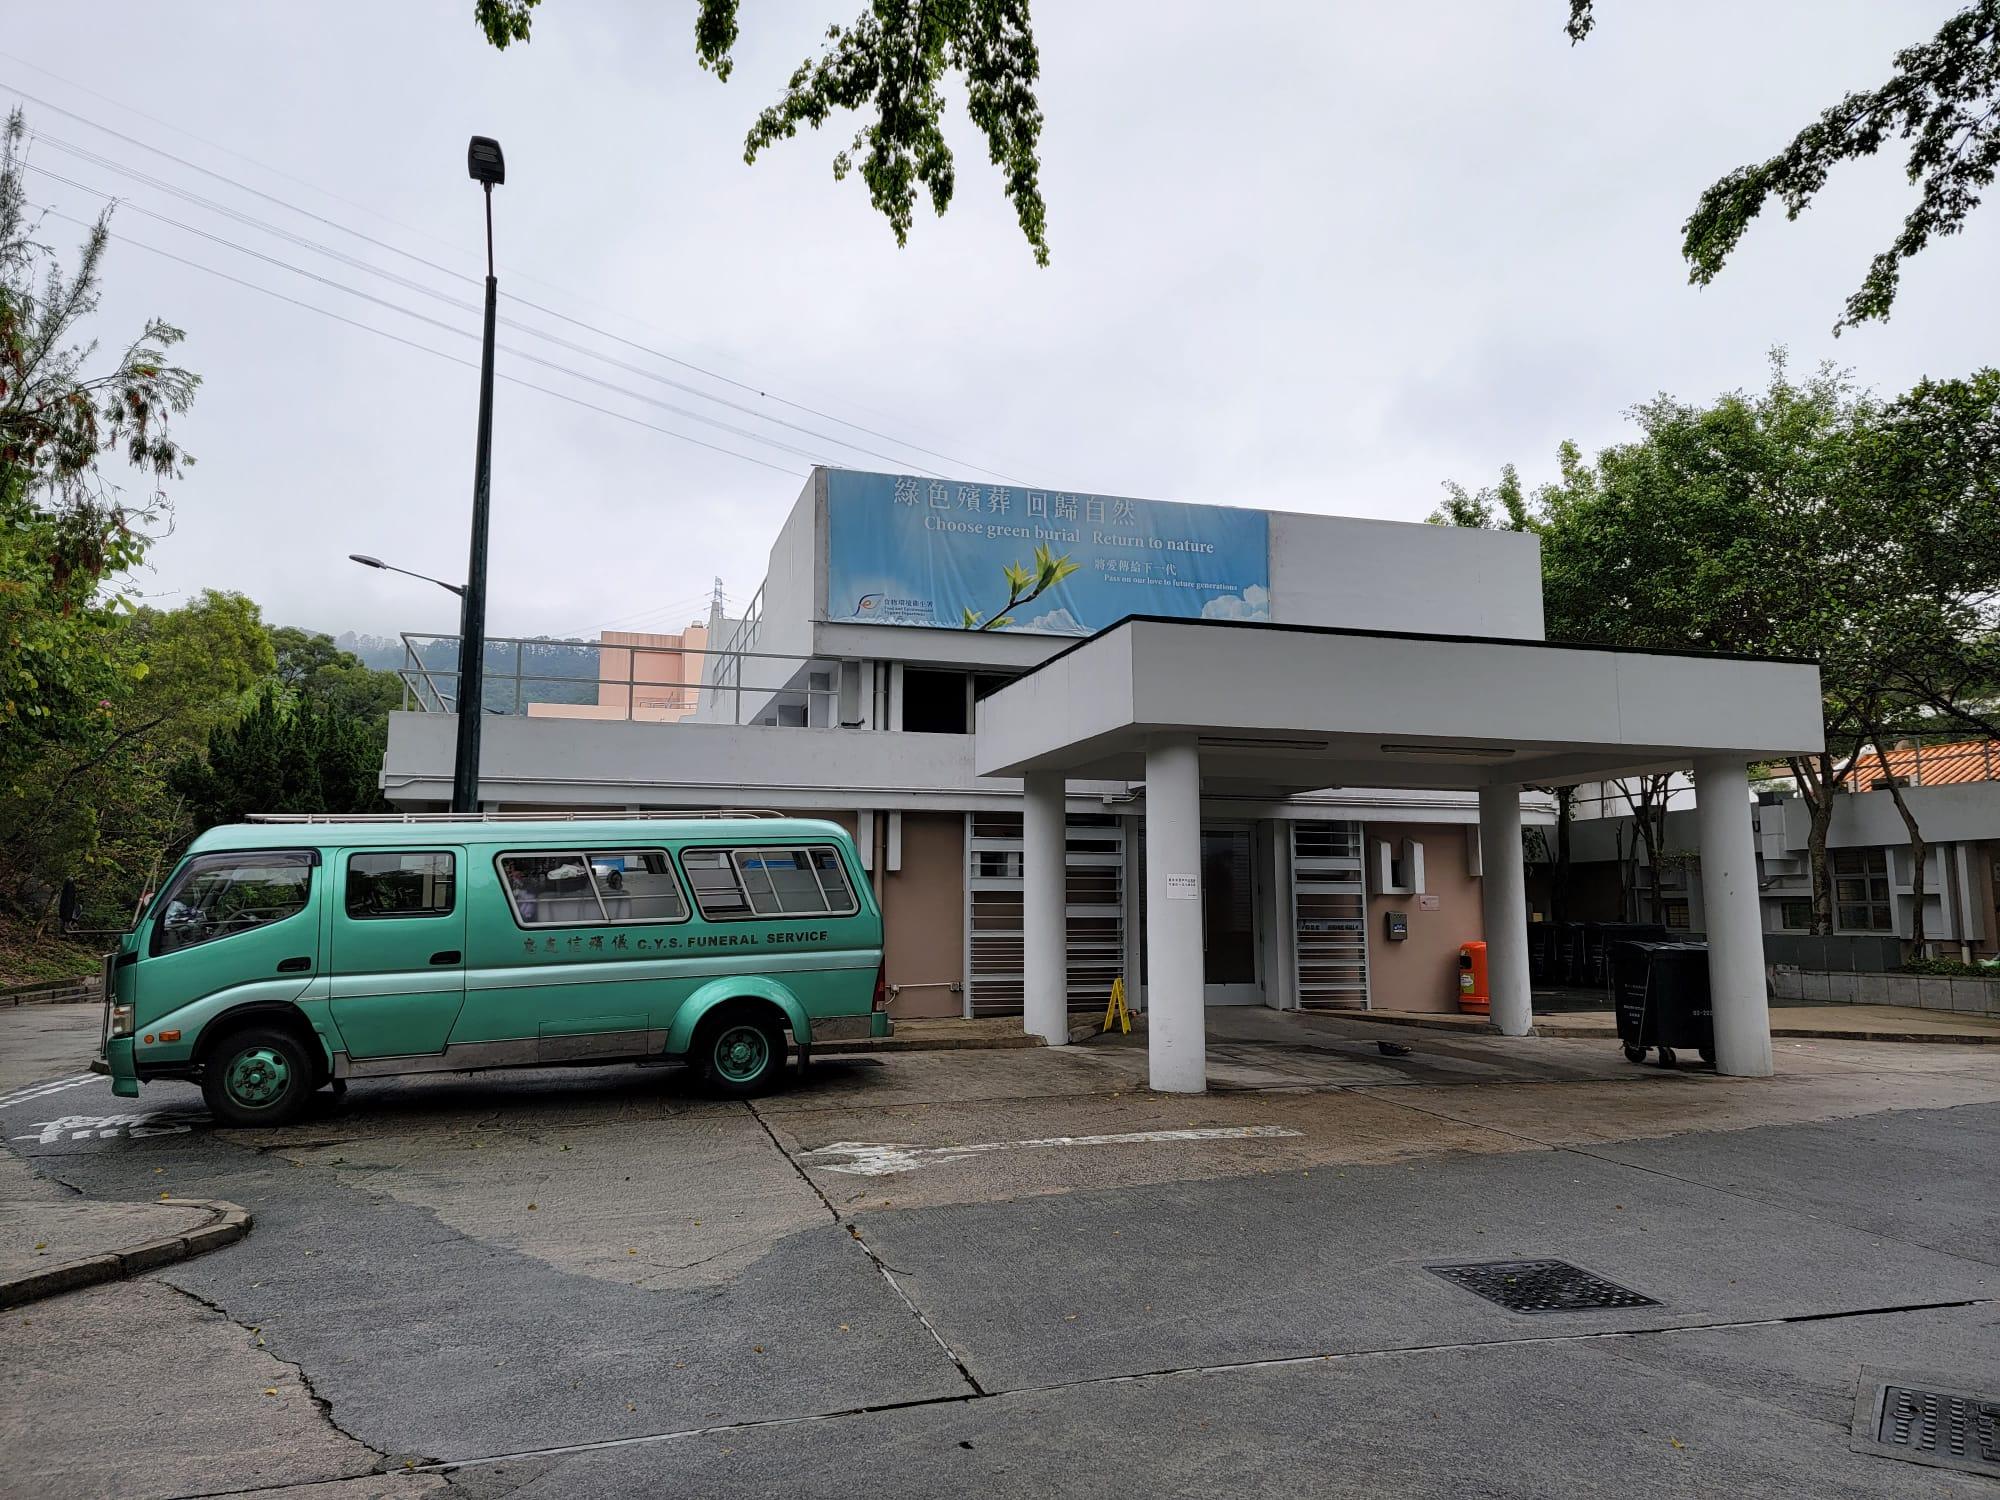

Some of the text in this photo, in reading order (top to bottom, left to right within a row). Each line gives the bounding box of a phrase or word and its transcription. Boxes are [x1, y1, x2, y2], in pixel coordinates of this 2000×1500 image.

[893, 476, 1135, 527] 綠色殯葬 回歸自然
[924, 516, 1215, 553] Choose green burial Return to nature
[1104, 573, 1121, 582] Pass
[1147, 576, 1164, 585] love
[1164, 578, 1172, 586] to
[1172, 578, 1195, 588] future
[1196, 581, 1238, 592] generations
[637, 930, 828, 950] C.Y.S. FUNERAL SERVICE
